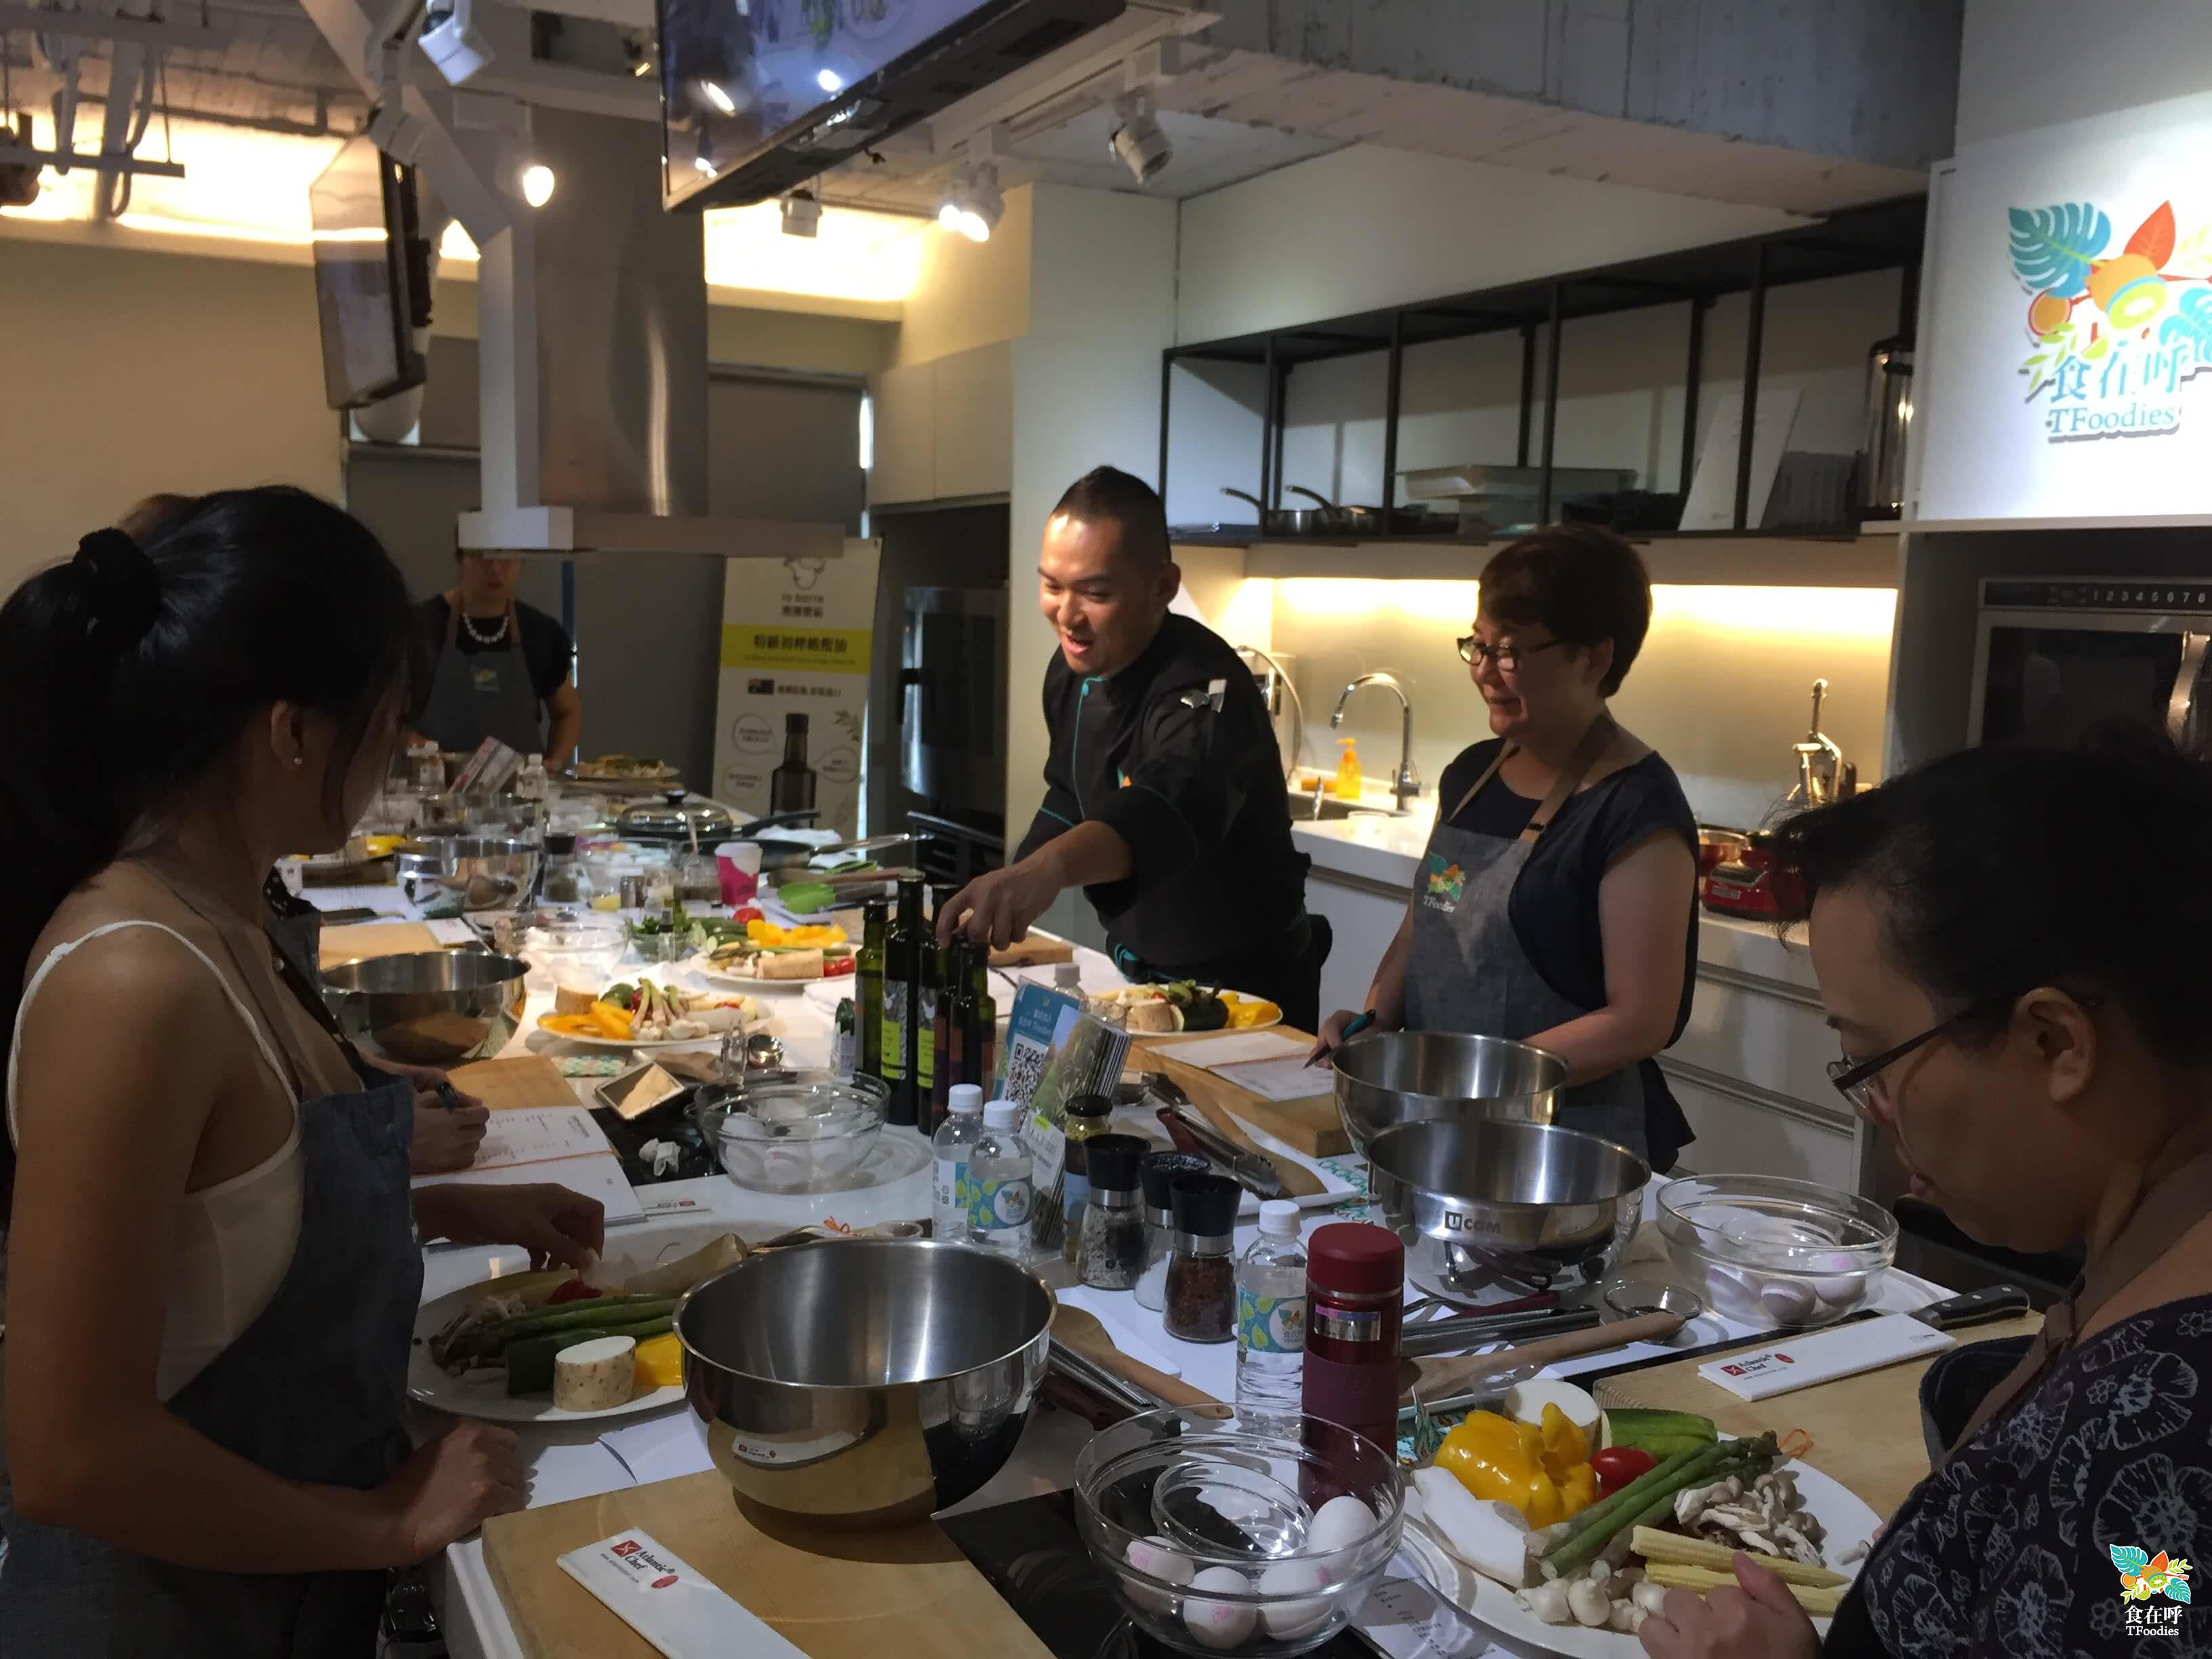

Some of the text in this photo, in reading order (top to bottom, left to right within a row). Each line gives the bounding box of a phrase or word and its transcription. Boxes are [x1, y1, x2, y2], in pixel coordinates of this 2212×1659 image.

[2049, 402, 2175, 433] TFoodies
[2106, 590, 2114, 602] 2
[2121, 591, 2129, 602] 3
[2136, 592, 2144, 602] 4
[2167, 591, 2175, 602] 6
[2182, 592, 2190, 603] 7
[624, 1555, 648, 1570] Chef
[636, 1550, 668, 1573] Atlantic
